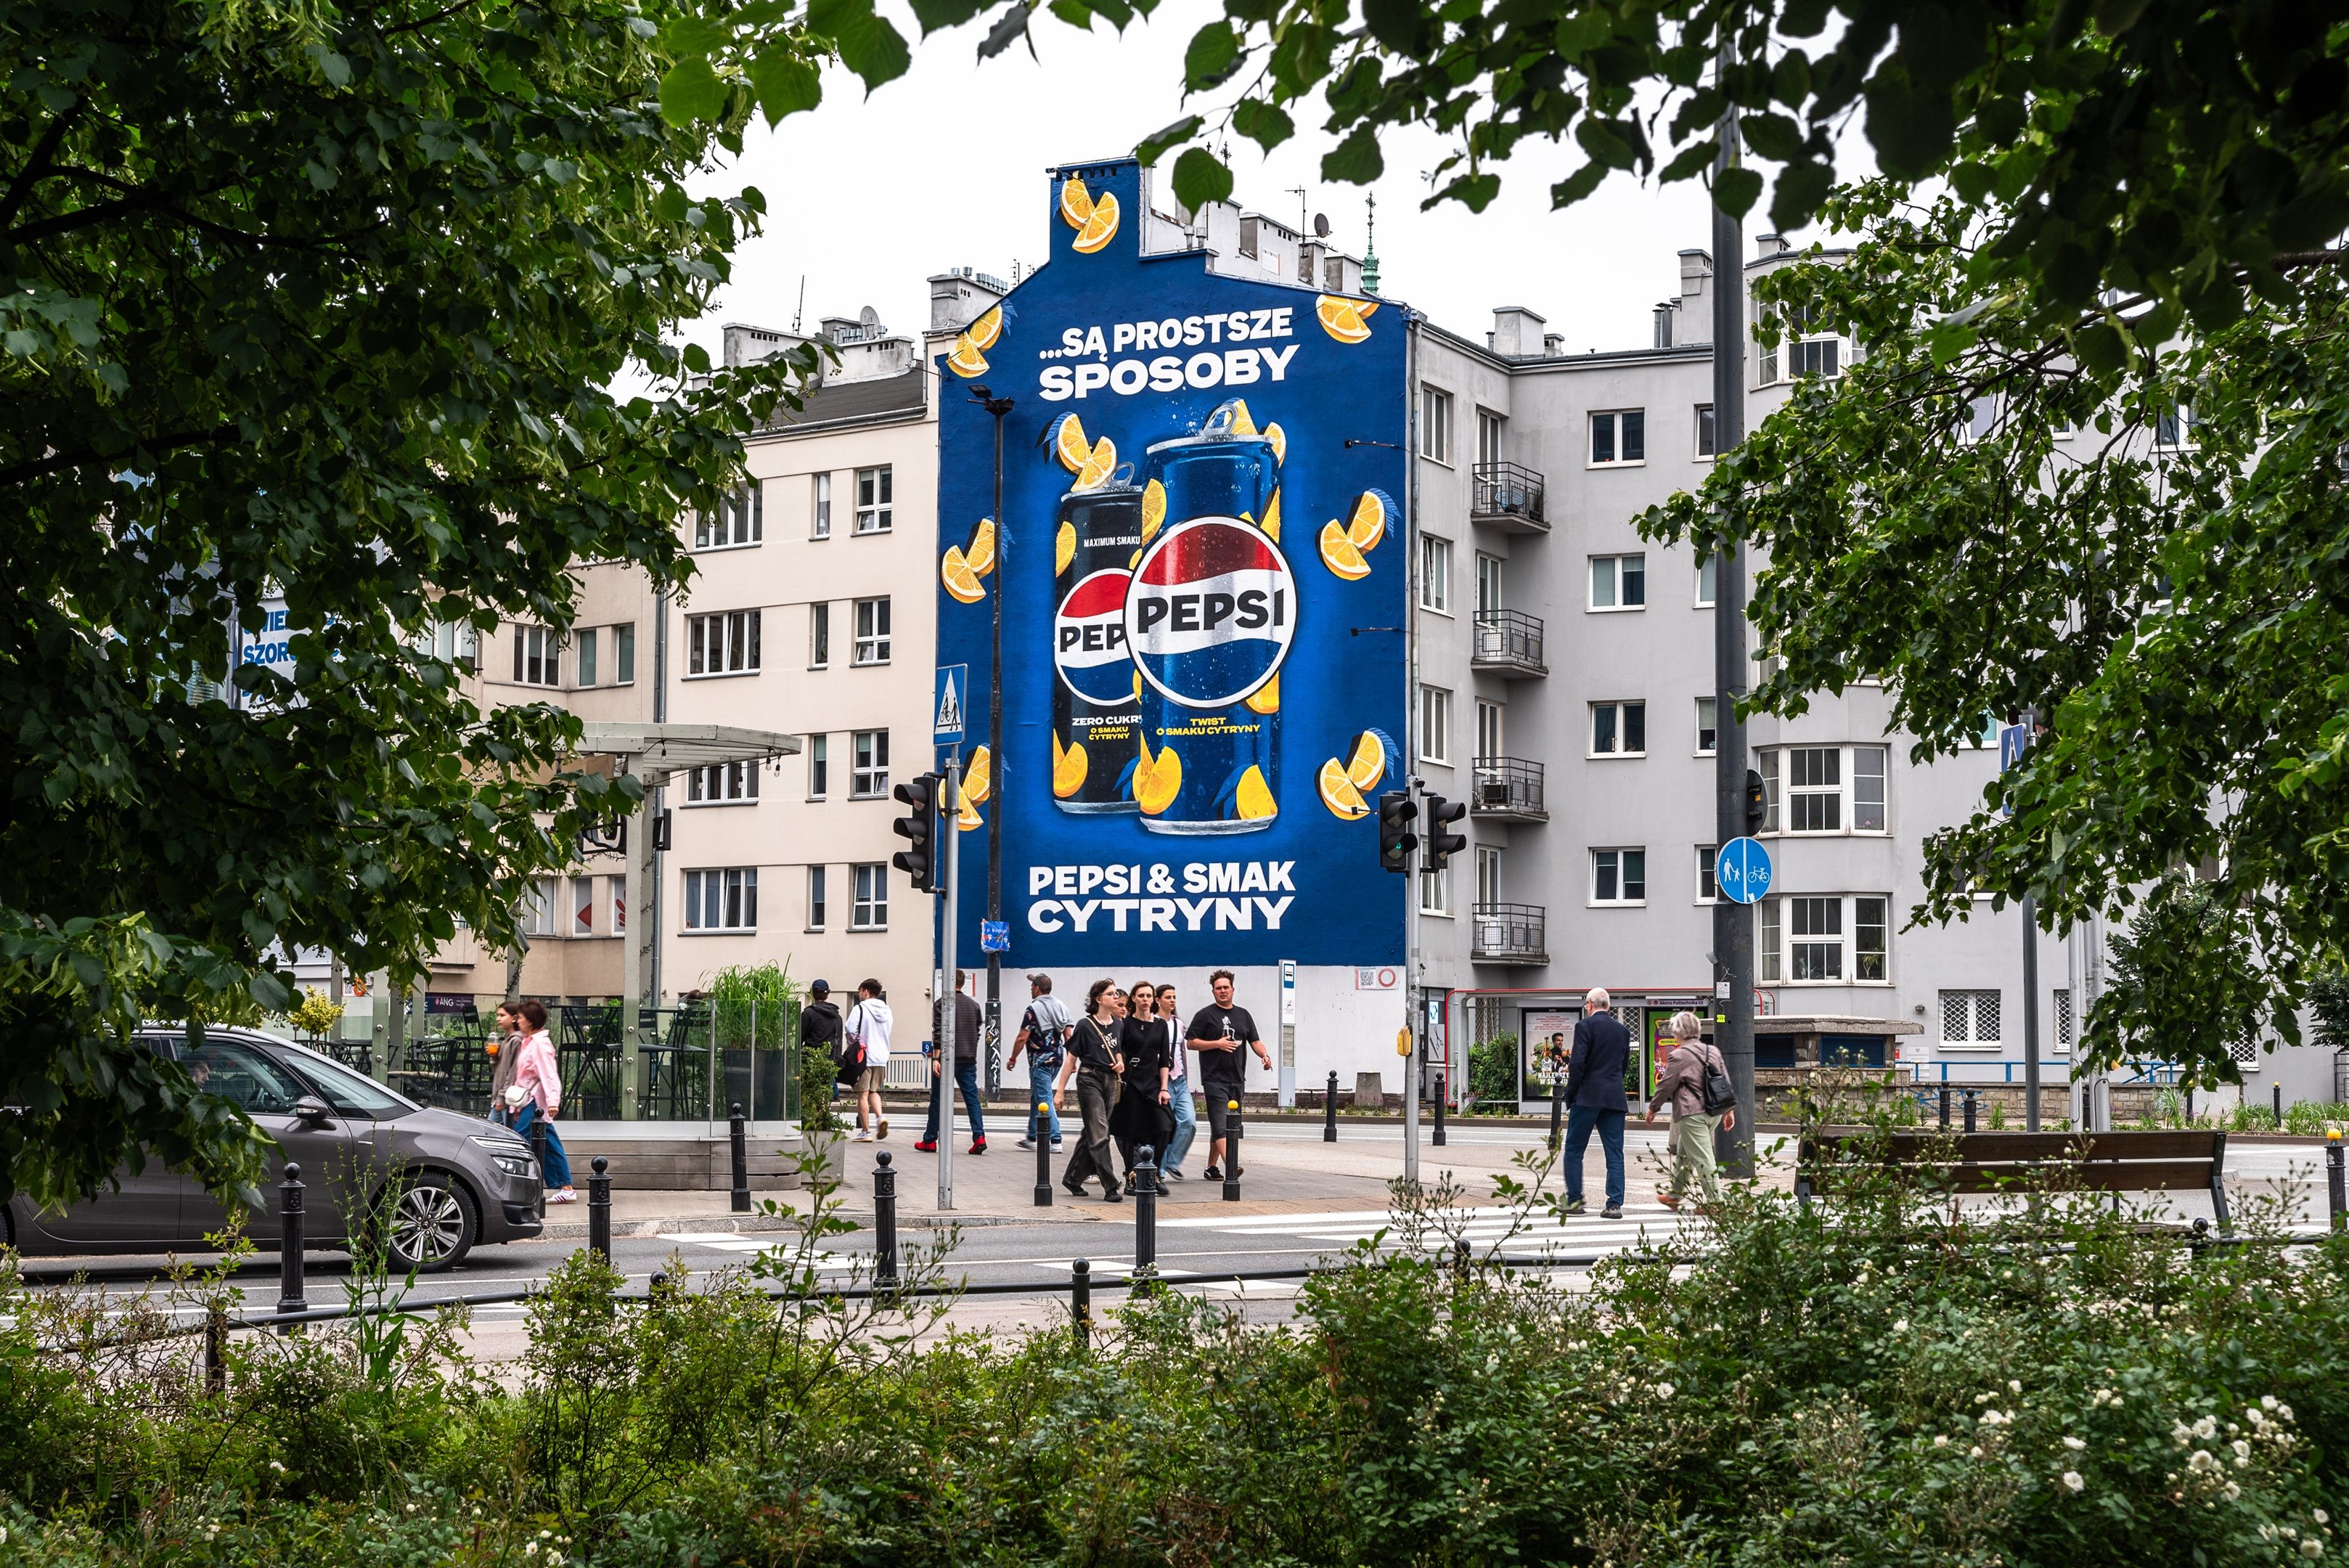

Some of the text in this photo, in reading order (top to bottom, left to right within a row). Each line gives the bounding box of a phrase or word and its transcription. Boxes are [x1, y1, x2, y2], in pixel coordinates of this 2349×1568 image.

[1039, 306, 1293, 362] ...SĄ PROSTSZE
[1039, 344, 1301, 401] SPOSOBY
[1084, 536, 1141, 547] MAXIMUM SMAKU
[1137, 588, 1284, 634] PEPSI
[1072, 716, 1104, 726] ZERO
[1156, 724, 1261, 736] O SMAKU CYTRYNY
[1190, 717, 1227, 726] TWIST
[1029, 860, 1296, 896] PEPSI & SMAK
[1027, 896, 1296, 934] CYTRYNY
[440, 997, 454, 1007] ANG
